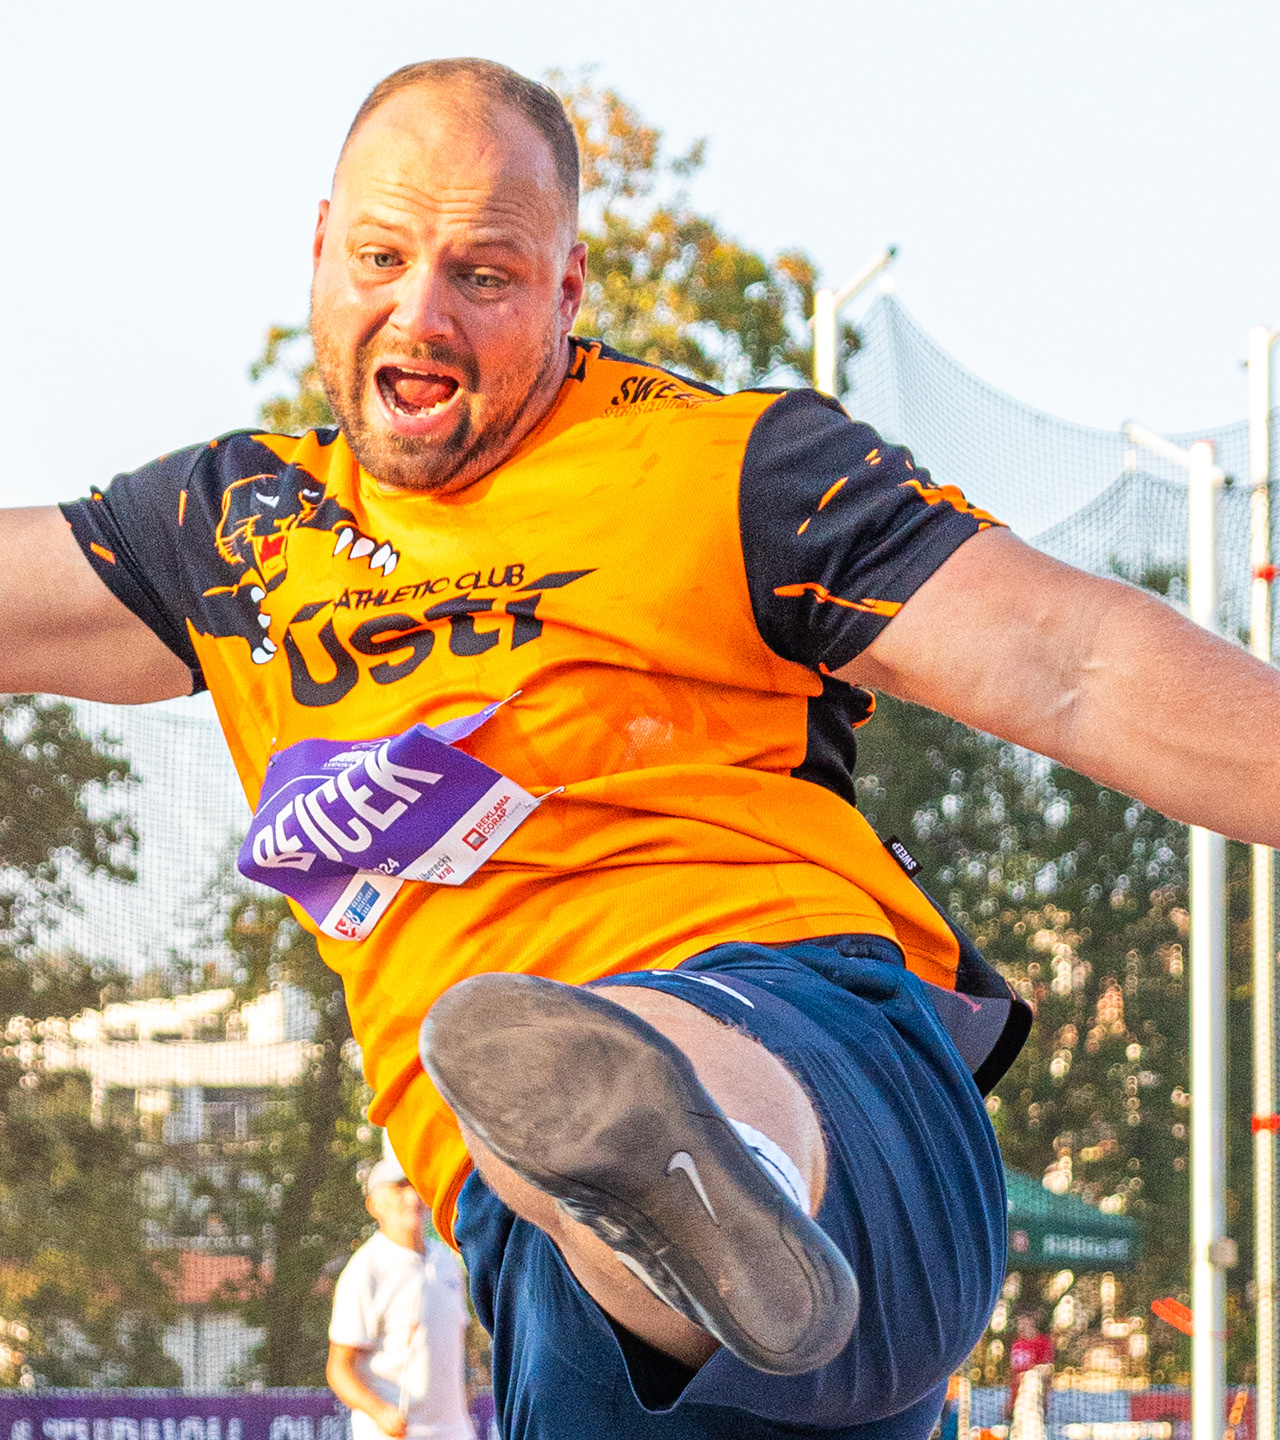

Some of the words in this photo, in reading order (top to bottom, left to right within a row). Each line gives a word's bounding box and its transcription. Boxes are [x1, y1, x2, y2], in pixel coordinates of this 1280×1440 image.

[331, 578, 451, 612] ATHLETIC
[454, 563, 525, 591] CLUB
[476, 794, 511, 830] REKLAMA
[483, 808, 507, 835] CORAP
[892, 842, 917, 870] SWEEP
[436, 863, 455, 881] kraj
